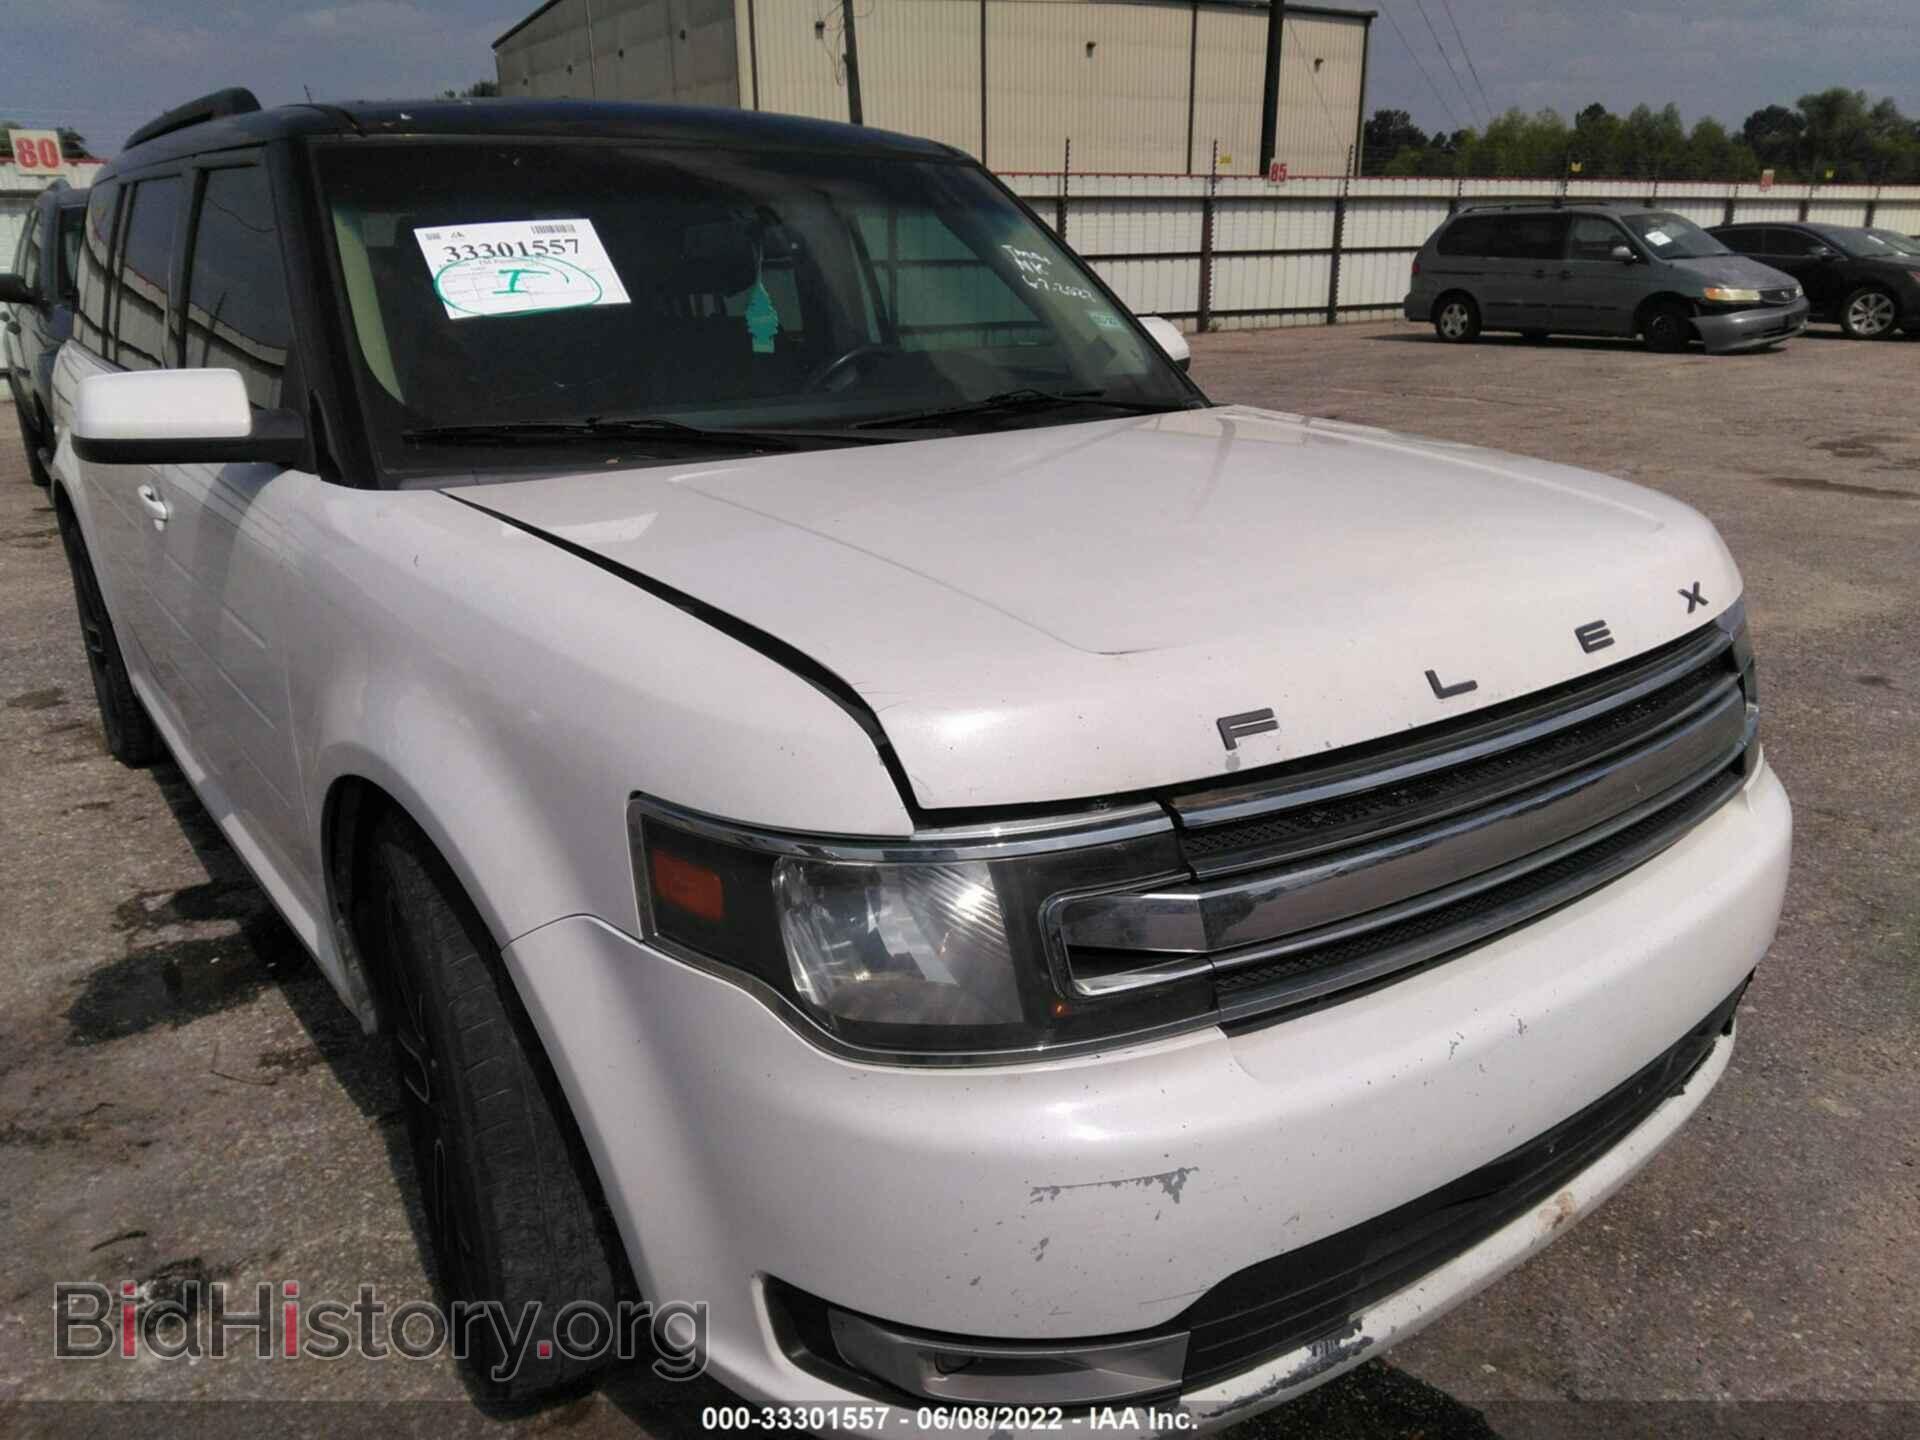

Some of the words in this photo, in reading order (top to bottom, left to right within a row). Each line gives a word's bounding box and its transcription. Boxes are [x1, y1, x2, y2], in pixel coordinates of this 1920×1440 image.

[16, 137, 61, 168] 80
[1270, 162, 1288, 182] 85
[442, 238, 580, 263] 33301557
